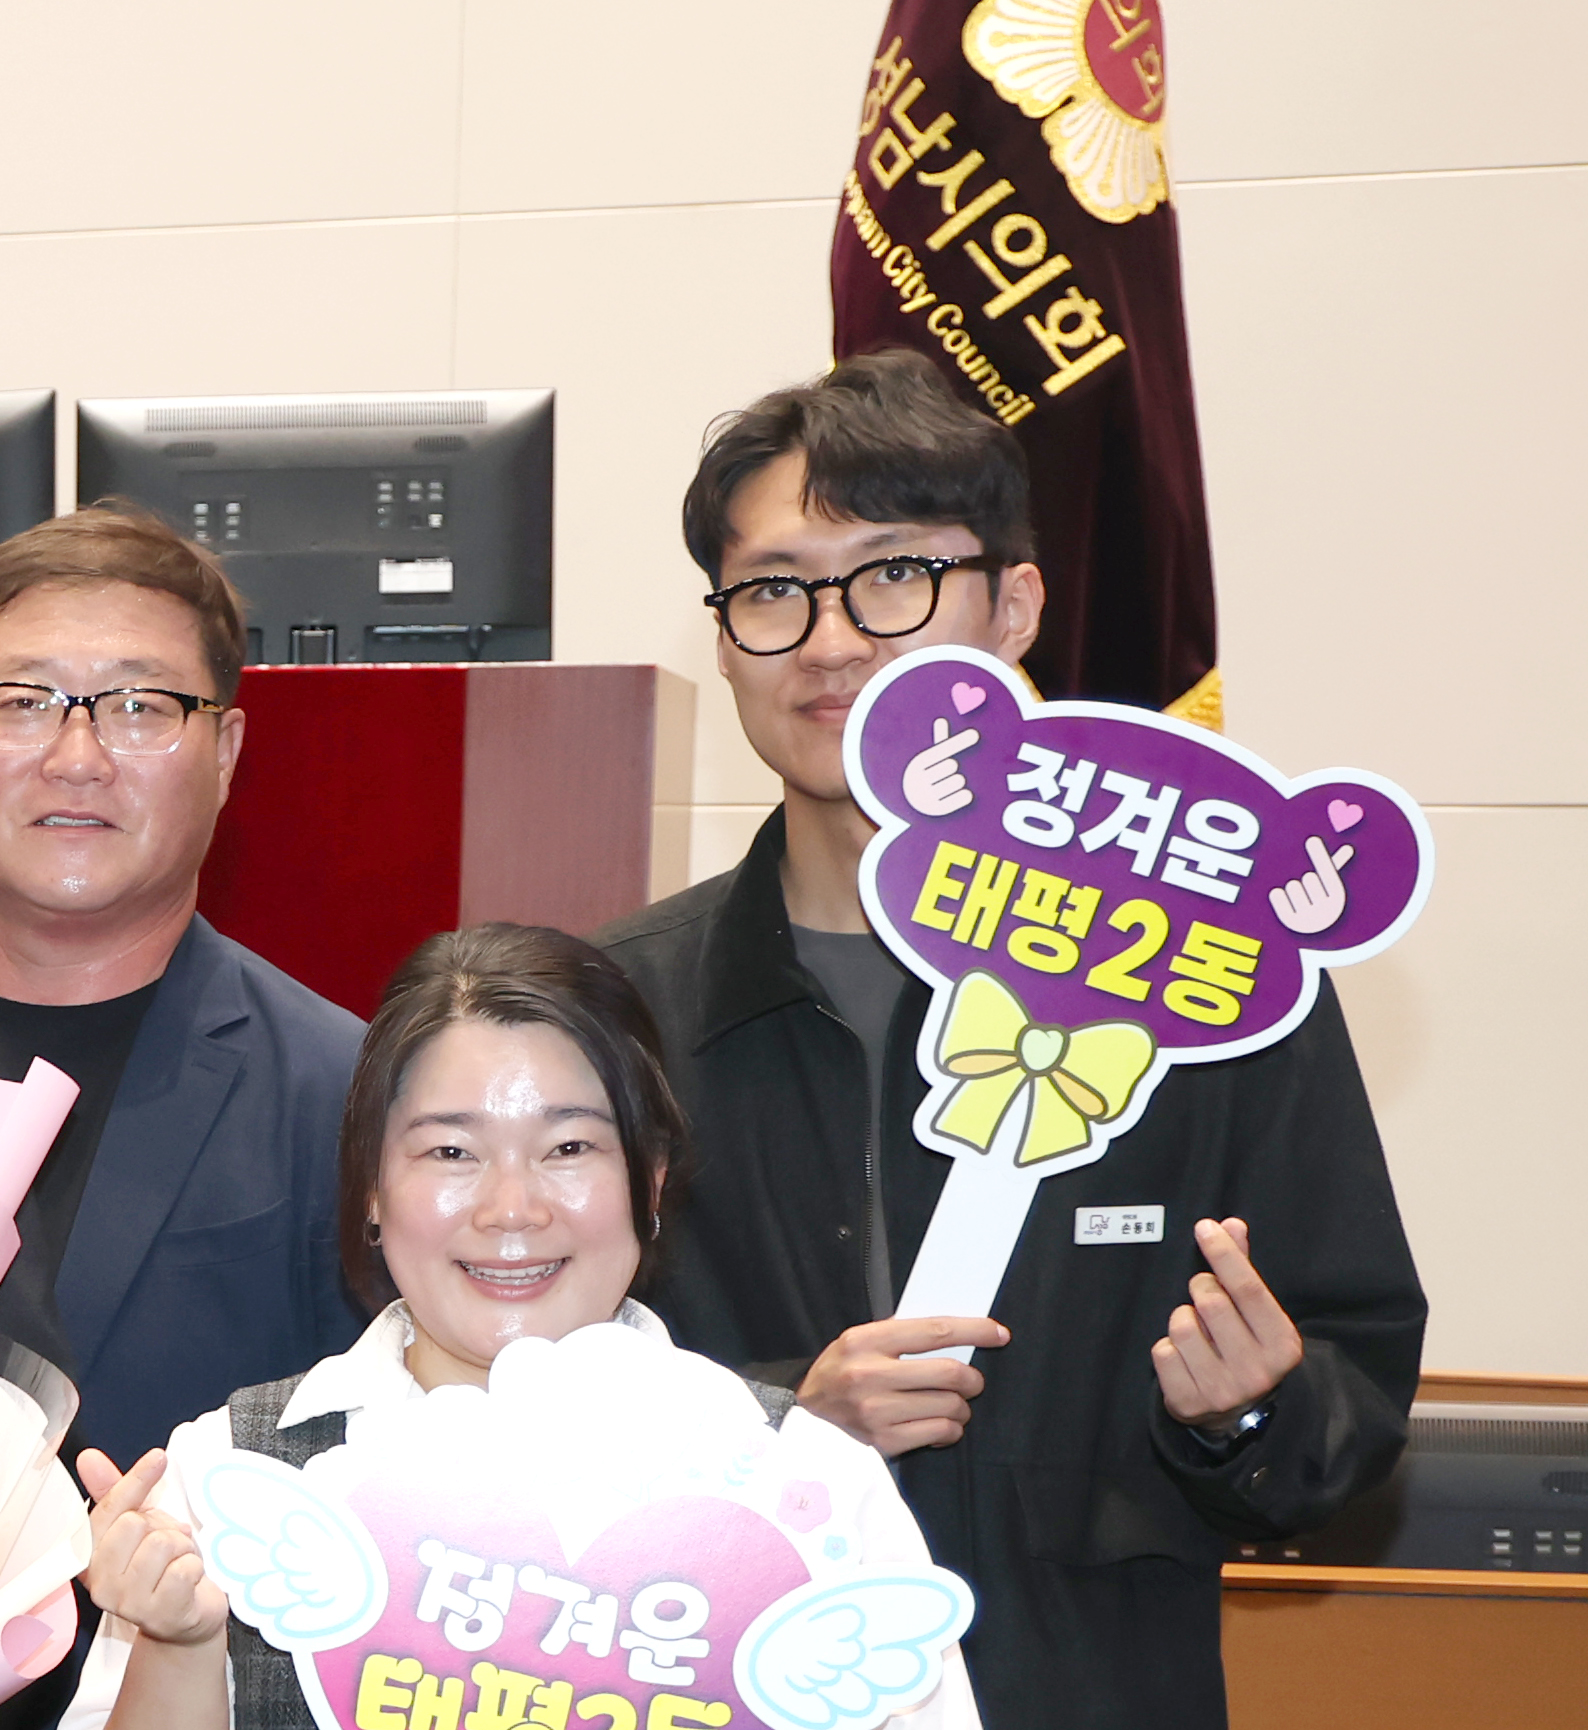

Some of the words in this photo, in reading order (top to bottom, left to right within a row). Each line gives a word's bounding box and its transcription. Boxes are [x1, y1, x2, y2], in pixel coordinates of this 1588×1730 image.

[882, 244, 937, 314] City
[926, 303, 1037, 426] Council
[1001, 741, 1261, 905] 정겨운
[910, 840, 1263, 1026] 태평2동
[416, 1538, 711, 1686] 정겨운
